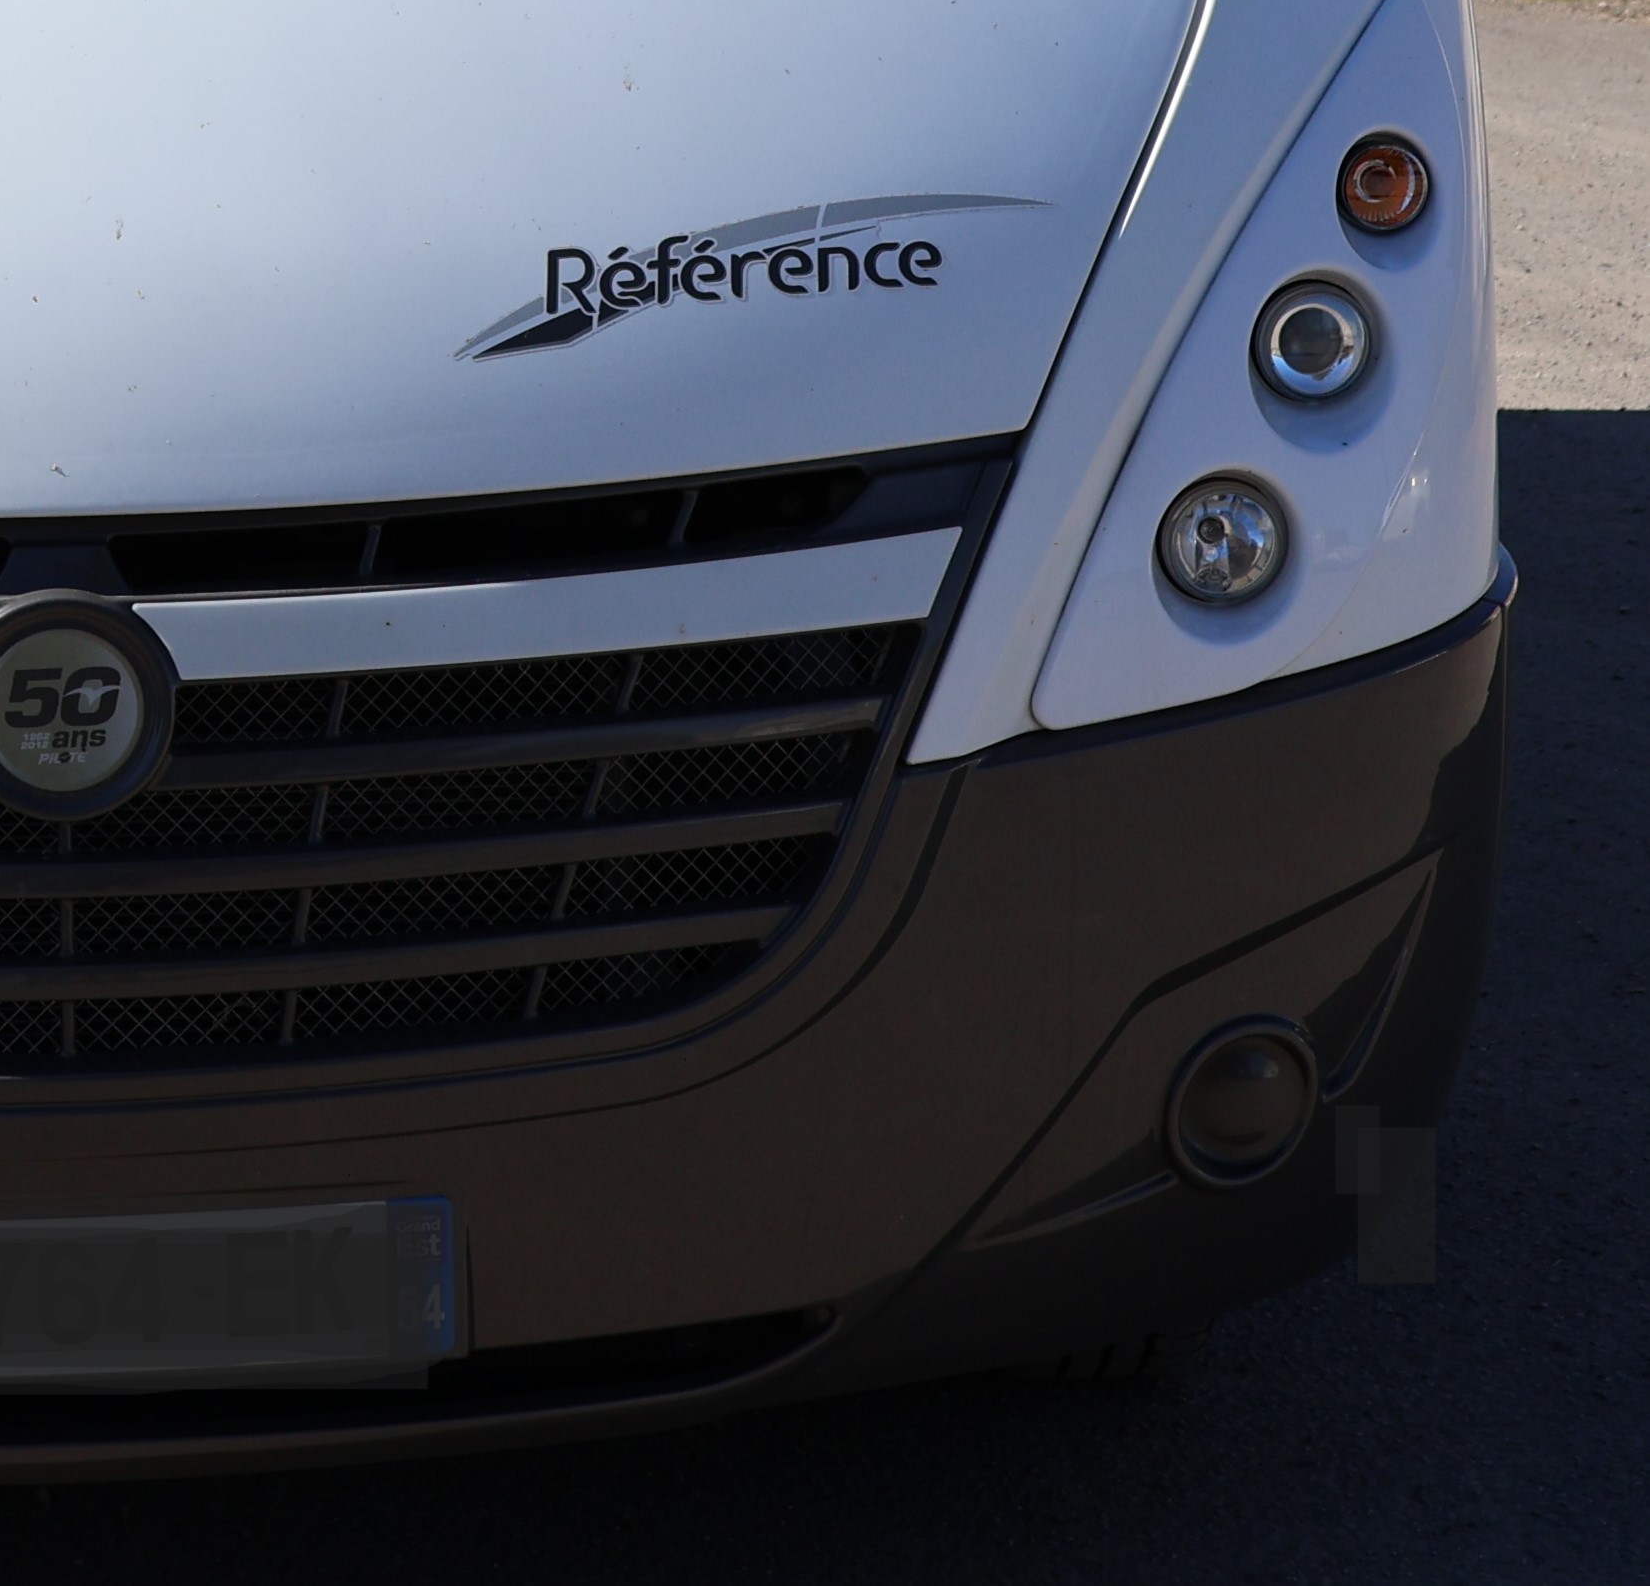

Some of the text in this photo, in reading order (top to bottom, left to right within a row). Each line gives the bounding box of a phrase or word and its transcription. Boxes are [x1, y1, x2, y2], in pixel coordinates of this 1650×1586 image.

[545, 234, 943, 314] Référence
[4, 666, 121, 729] 50
[52, 729, 107, 752] ans
[396, 1218, 441, 1233] Grand
[396, 1233, 442, 1258] Est
[396, 1283, 446, 1333] 54
